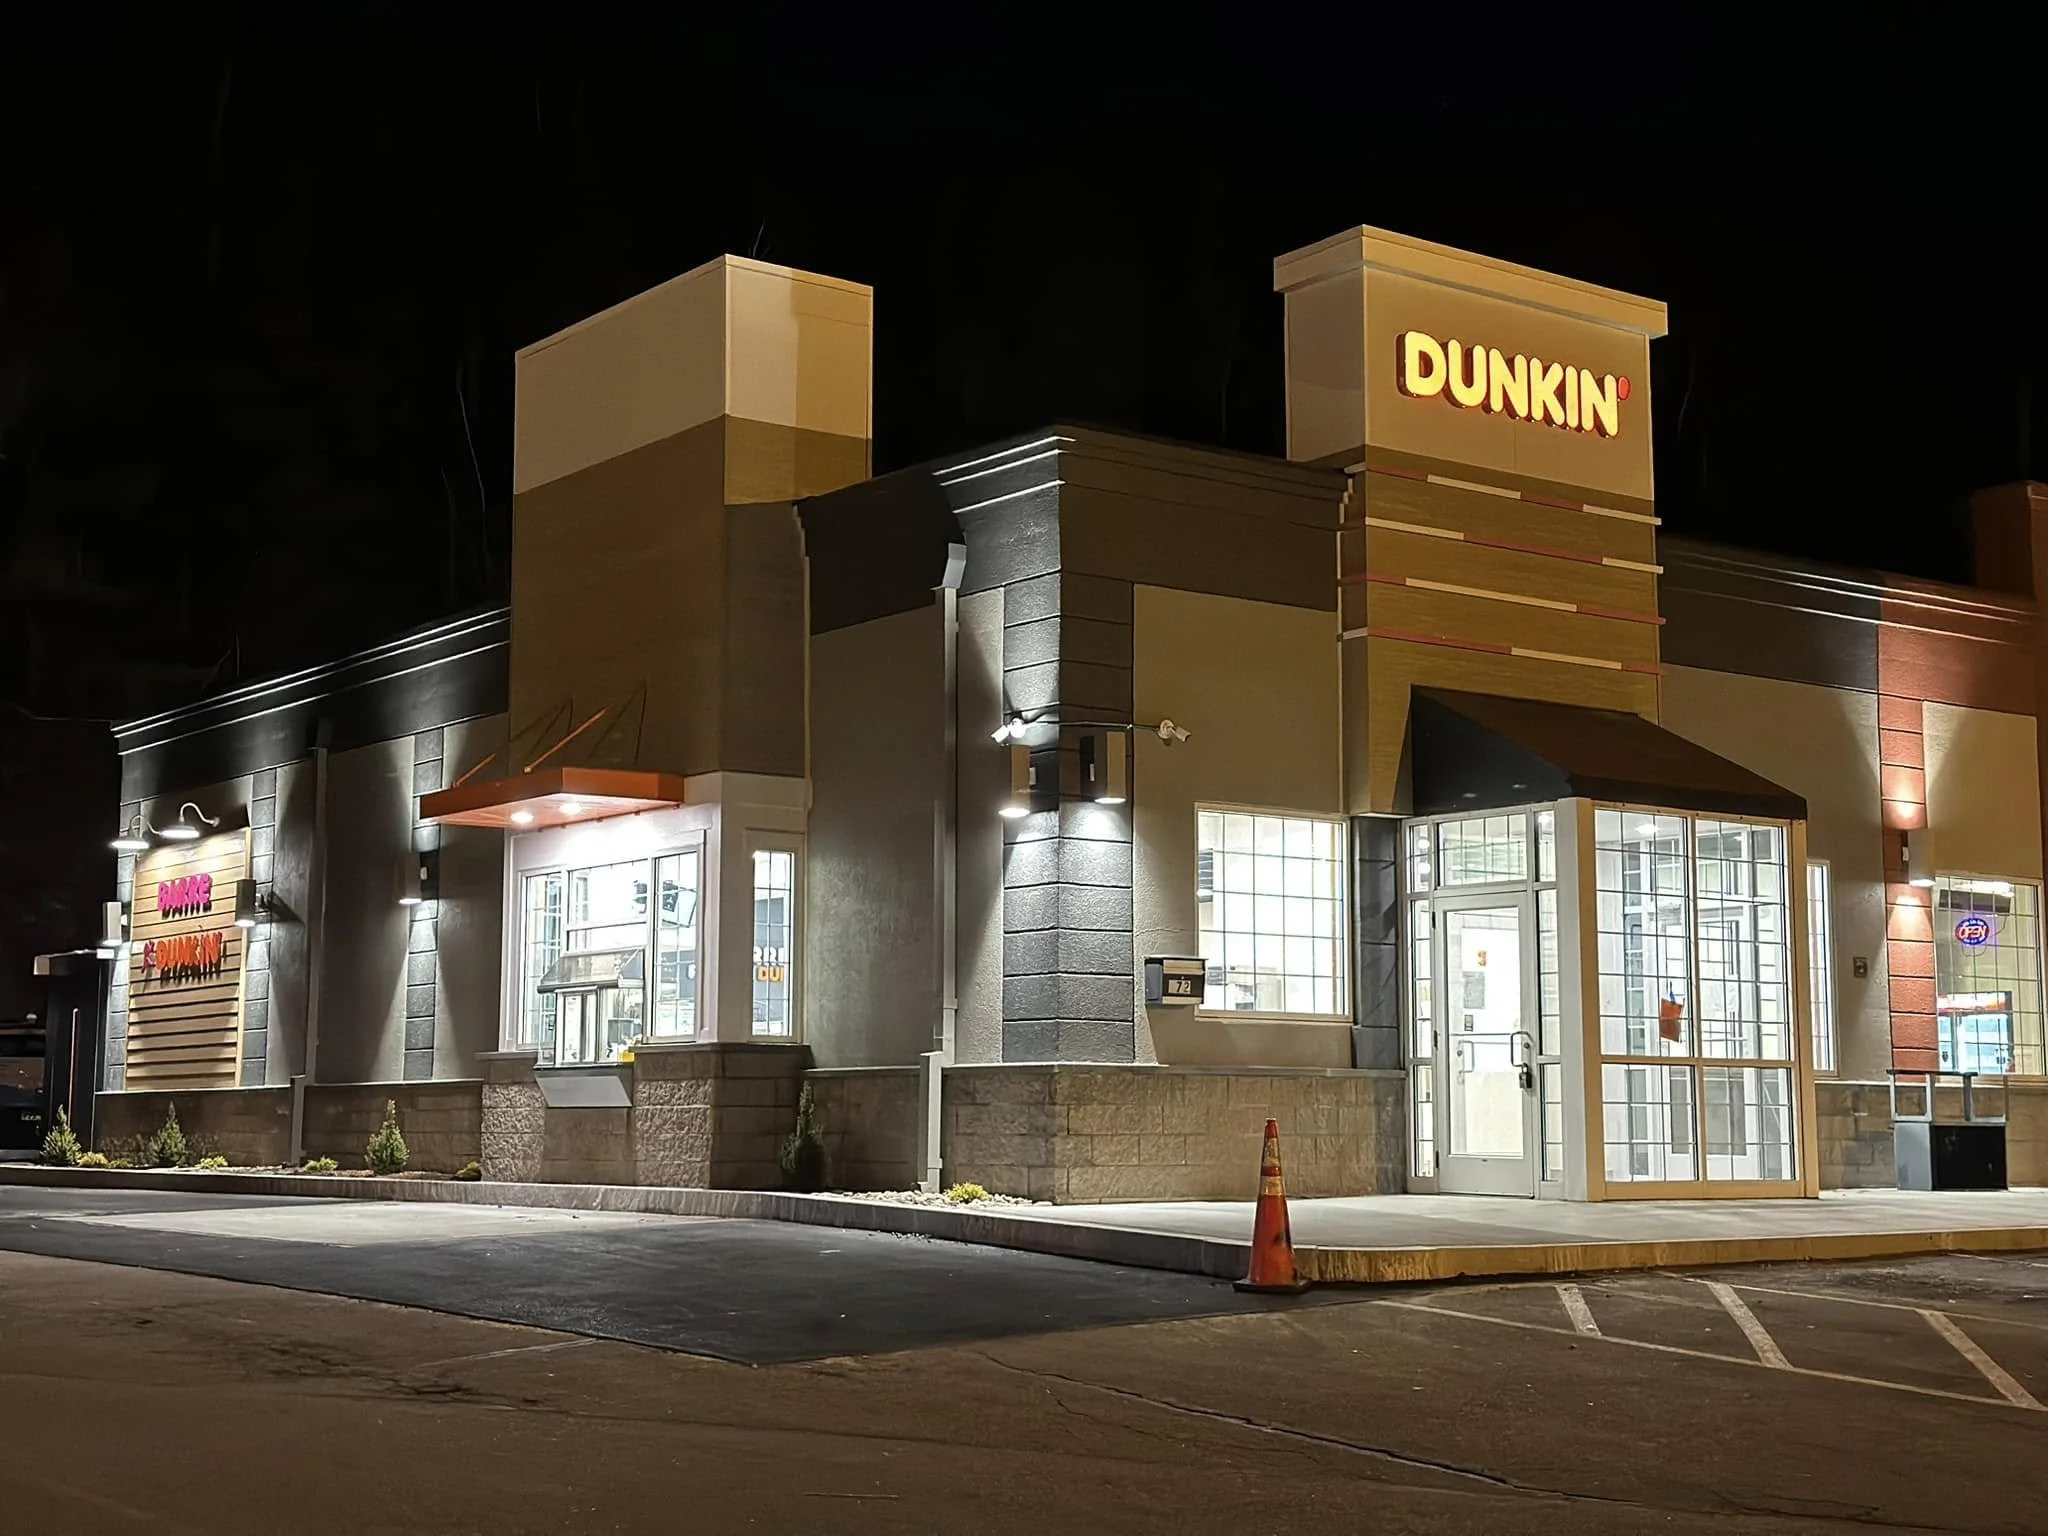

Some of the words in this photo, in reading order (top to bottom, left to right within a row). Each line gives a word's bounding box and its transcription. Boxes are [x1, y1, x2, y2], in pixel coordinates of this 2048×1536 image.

[1397, 330, 1630, 438] DUNKIN'
[1958, 925, 1987, 939] OPEN
[1176, 981, 1190, 993] 72
